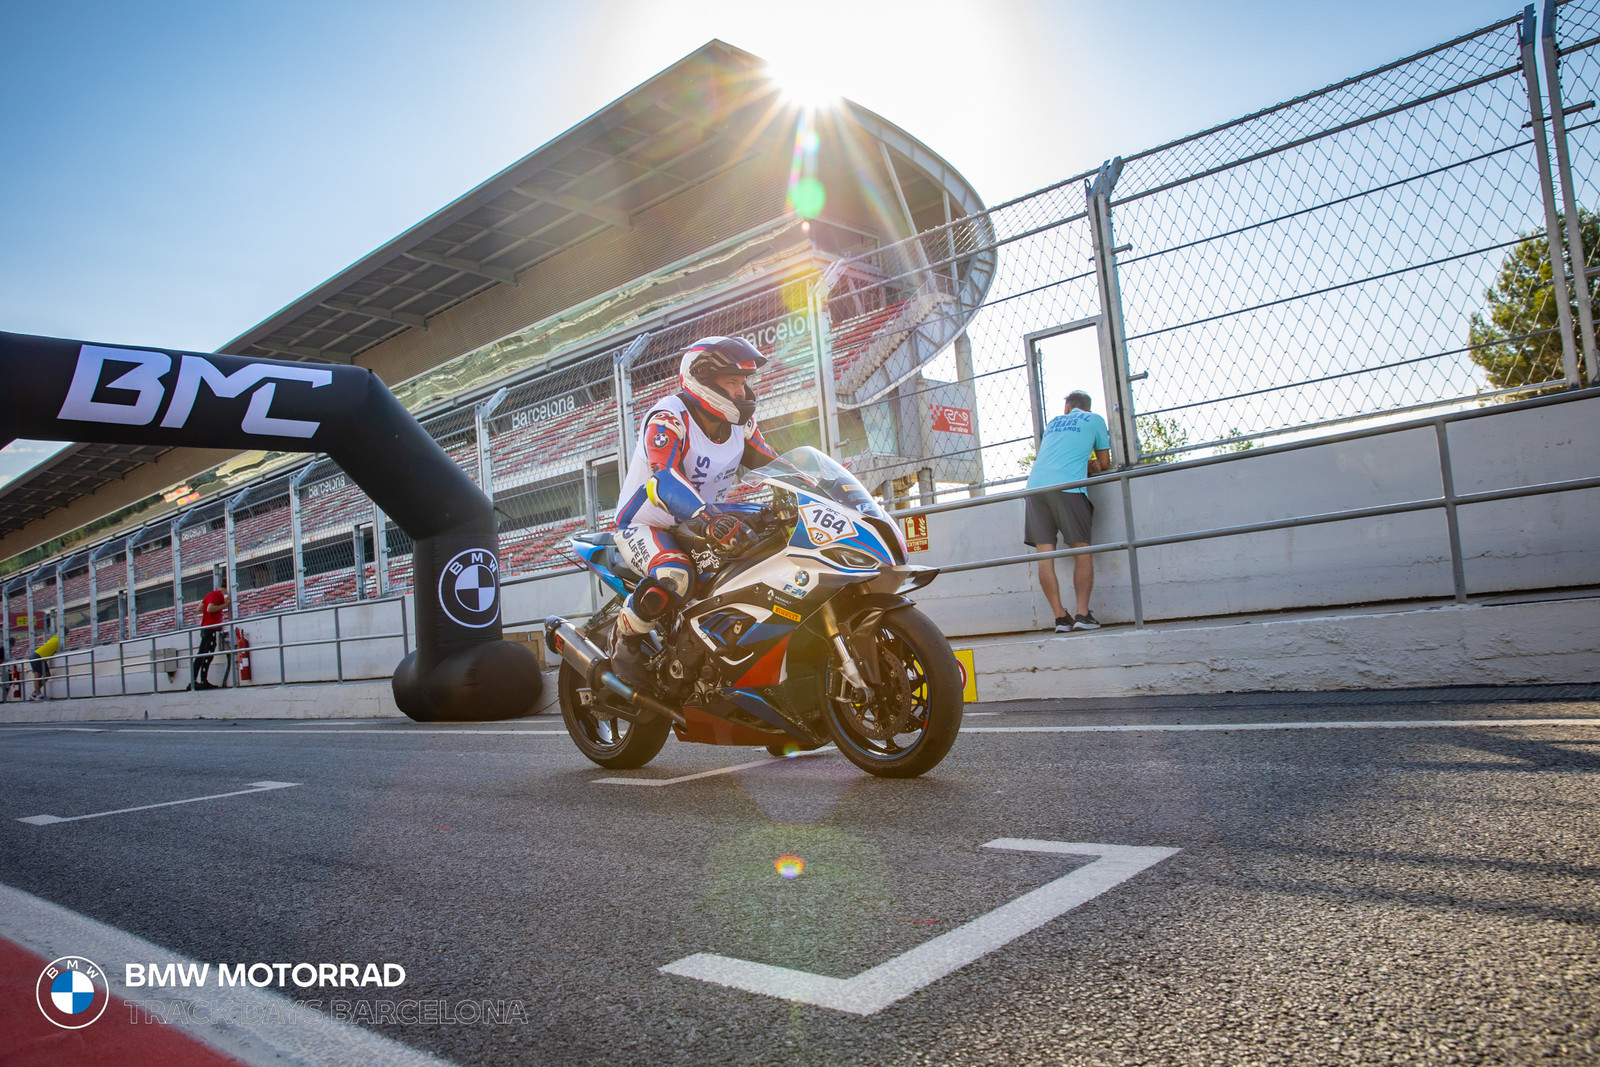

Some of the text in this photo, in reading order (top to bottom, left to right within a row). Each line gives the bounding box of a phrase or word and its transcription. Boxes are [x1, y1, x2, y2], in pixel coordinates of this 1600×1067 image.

[741, 316, 812, 349] arcelo
[57, 344, 332, 438] BMC
[511, 395, 575, 430] Barcelona
[812, 508, 847, 535] 164
[814, 531, 824, 542] 12
[906, 540, 928, 548] EXTINTOR
[628, 539, 643, 567] LIFE A
[636, 538, 650, 563] MAKE
[448, 552, 498, 577] BMW
[775, 606, 800, 621] PIRELLI
